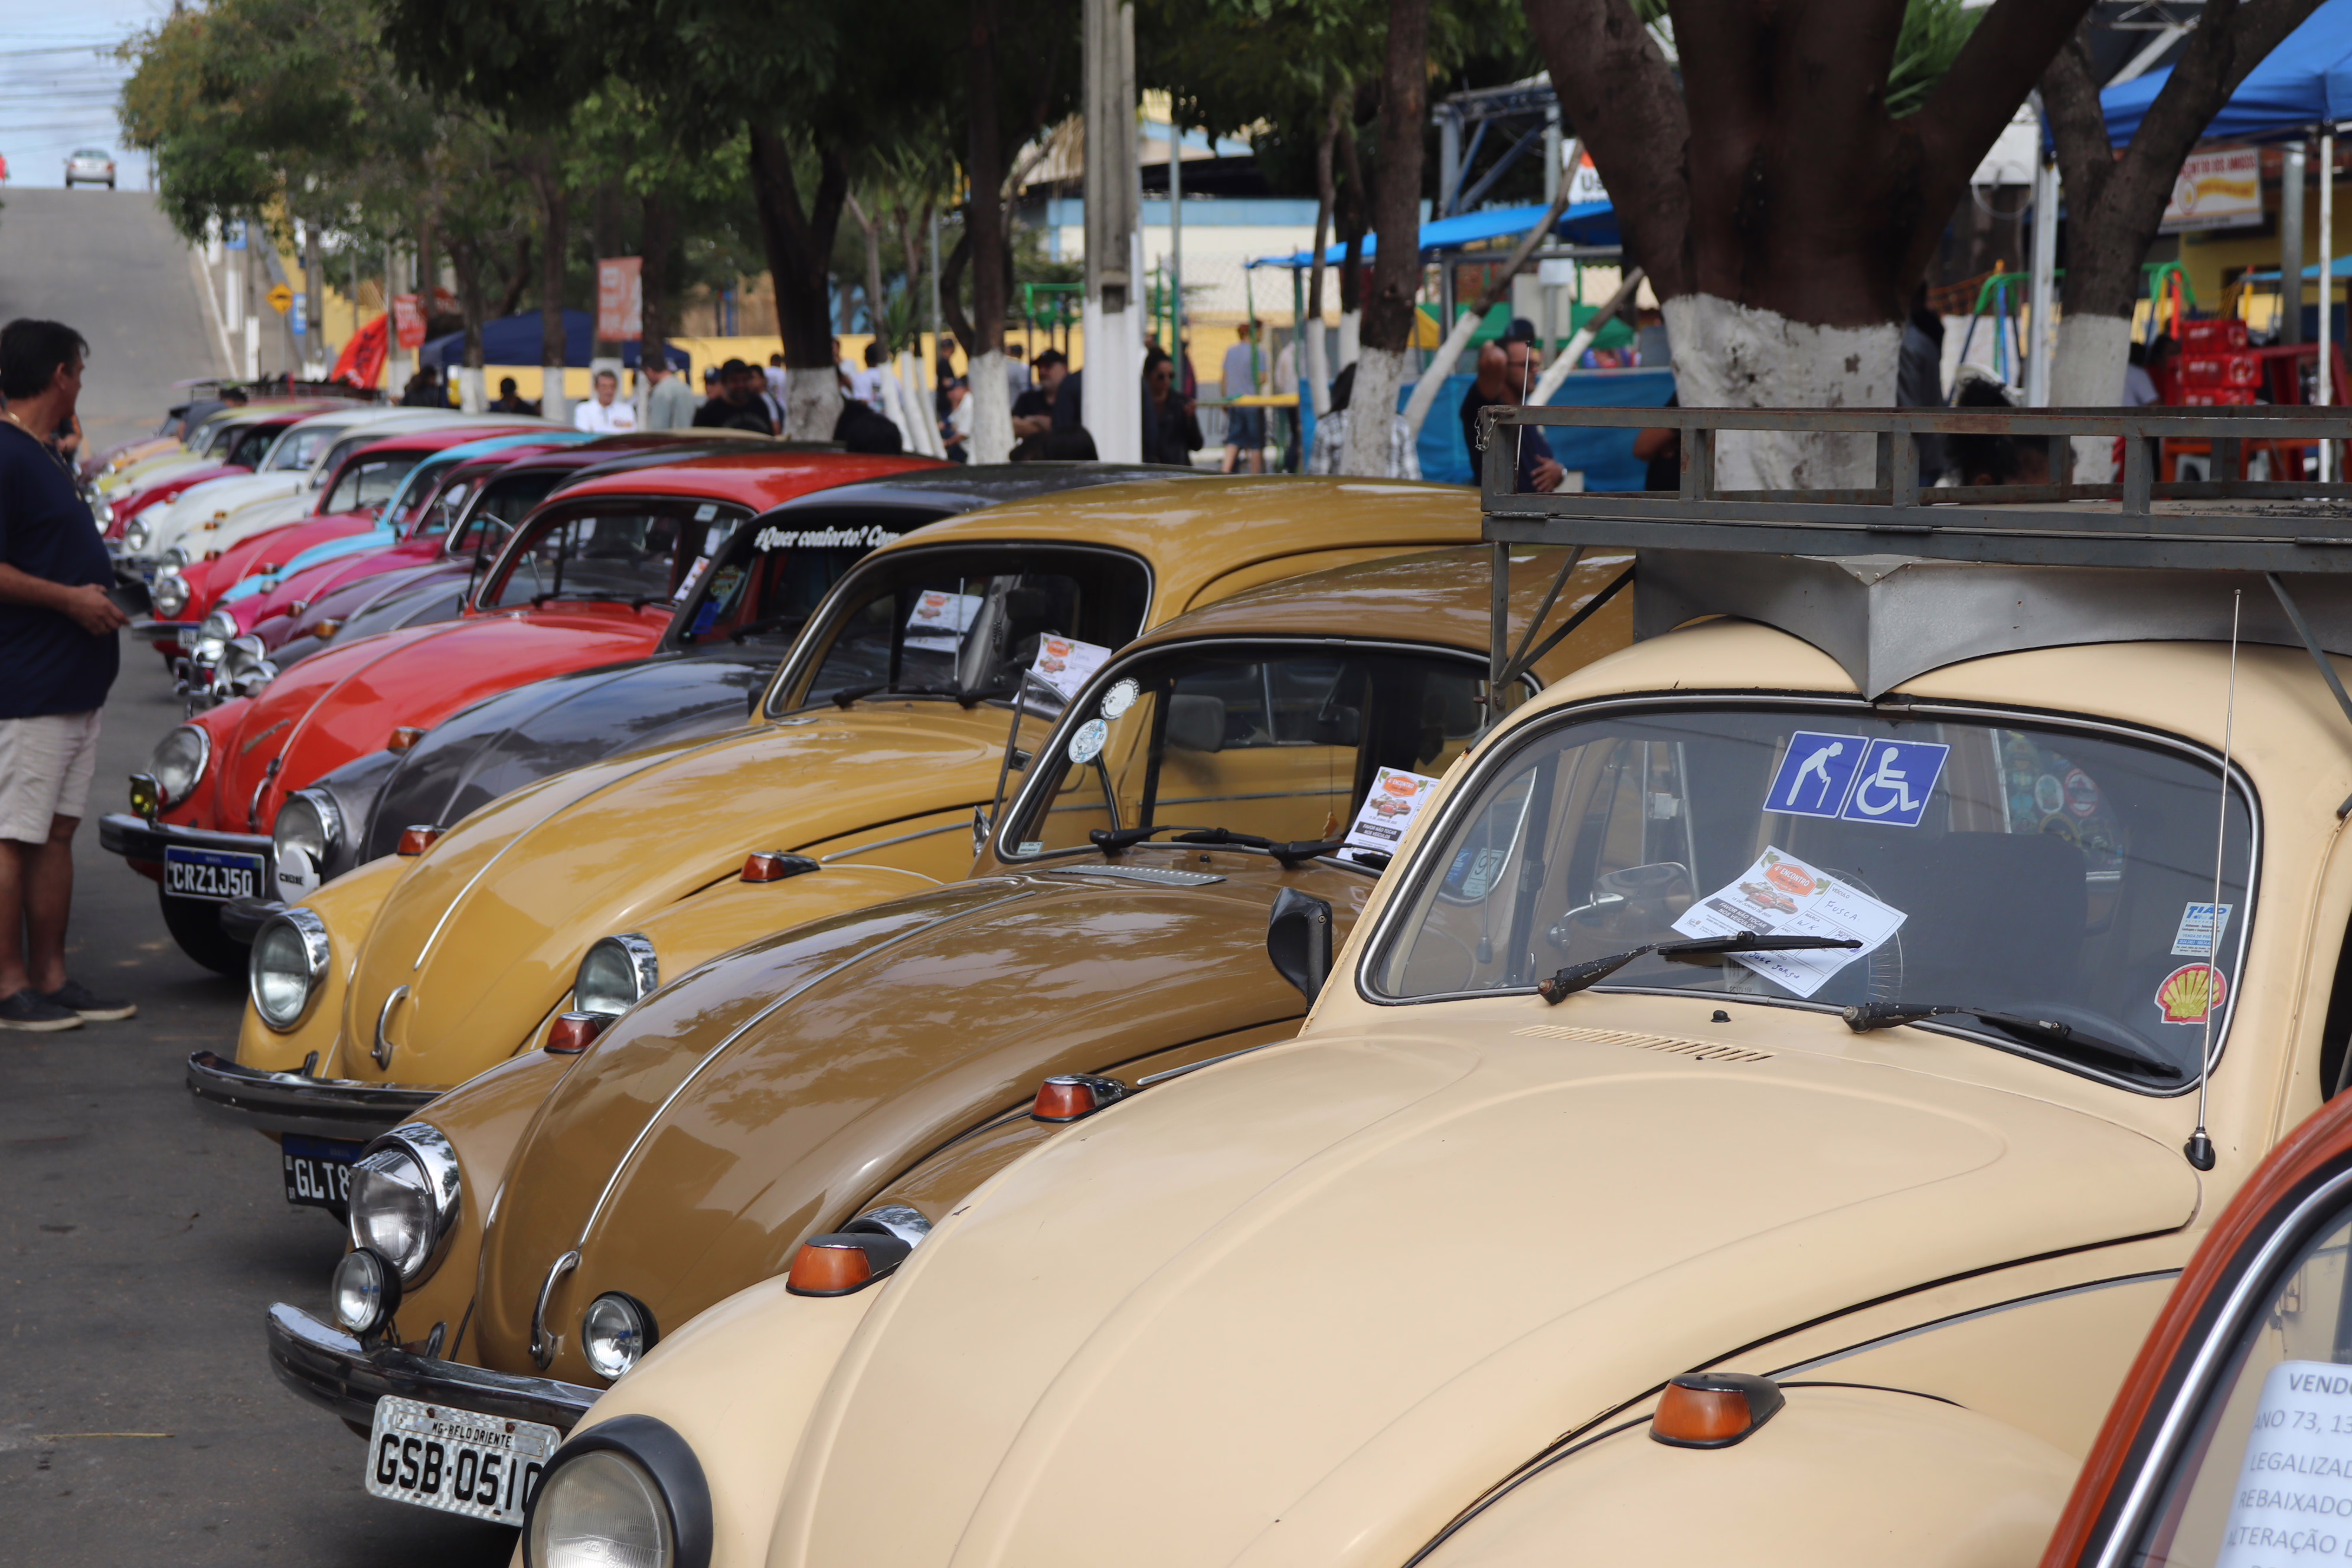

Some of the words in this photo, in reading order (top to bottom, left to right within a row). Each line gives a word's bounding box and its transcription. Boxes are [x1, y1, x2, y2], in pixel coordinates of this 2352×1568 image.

[754, 525, 799, 552] #Quer
[798, 525, 868, 548] conforto?
[1392, 779, 1415, 789] ENCONTRO
[1780, 868, 1810, 887] ENCONTRO
[1832, 886, 1850, 899] VEÍCULO
[1719, 902, 1739, 913] FAVOR
[1736, 909, 1750, 919] NÃO
[1747, 916, 1768, 929] TOCAR
[1742, 901, 1757, 911] JUNHO
[2186, 905, 2227, 919] TIÃO
[1718, 908, 1730, 917] NOS
[1730, 913, 1757, 930] VEÍCULOS
[1805, 913, 1821, 923] MARCA
[2289, 1373, 2352, 1396] VEND
[2252, 1409, 2285, 1430] ANO
[2292, 1410, 2321, 1435] 73,
[474, 1427, 512, 1448] ORIENTE
[2238, 1489, 2352, 1517] REBAIXADO
[2225, 1527, 2337, 1554] ALTERAÇÃO
